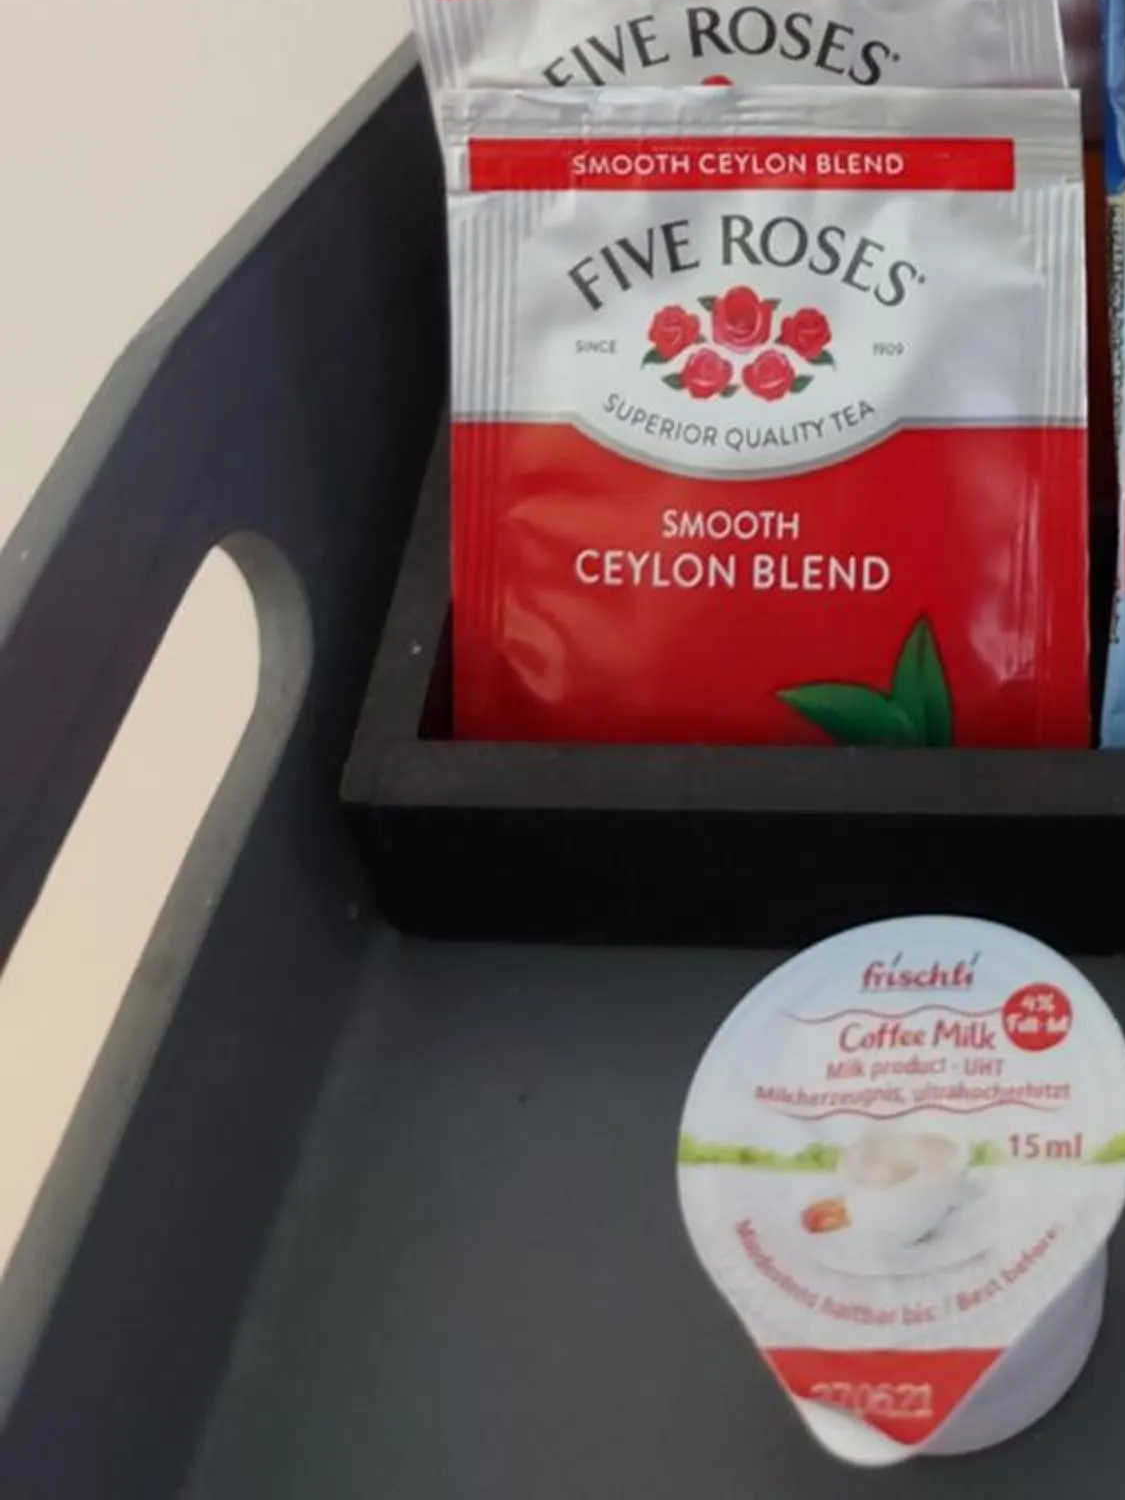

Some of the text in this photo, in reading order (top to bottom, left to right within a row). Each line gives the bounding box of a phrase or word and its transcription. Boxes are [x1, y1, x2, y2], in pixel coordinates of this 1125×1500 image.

[541, 5, 893, 88] FIVE ROSES
[571, 152, 905, 177] SMOOTH CEYLON BLEND
[566, 213, 920, 312] FIVE ROSES
[574, 339, 619, 355] SINCE
[601, 393, 876, 453] SUPERIOR QUALITY TEA
[661, 509, 800, 541] SMOOTH
[574, 548, 892, 593] CEYLON BLEND
[838, 1018, 998, 1053] Coffee Milk
[825, 1060, 866, 1081] Milk
[869, 1055, 948, 1082] product
[963, 1057, 1006, 1077] UHT
[1008, 1132, 1084, 1159] 15 ml
